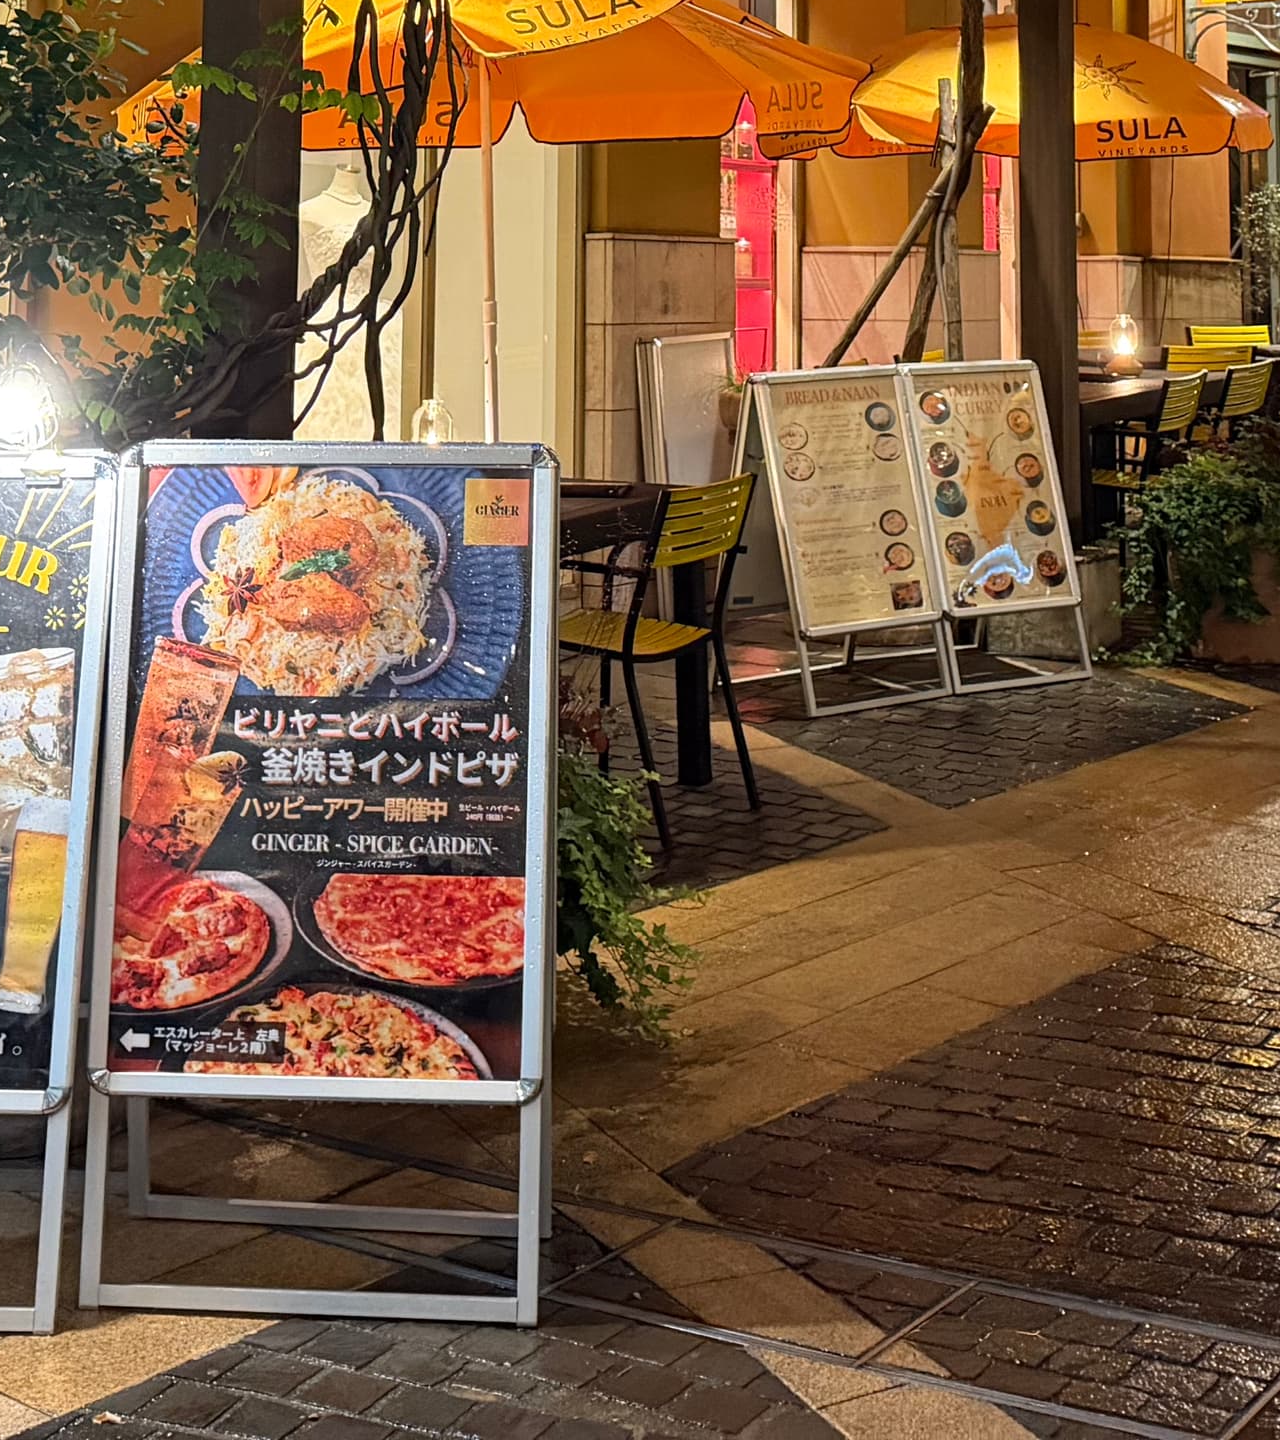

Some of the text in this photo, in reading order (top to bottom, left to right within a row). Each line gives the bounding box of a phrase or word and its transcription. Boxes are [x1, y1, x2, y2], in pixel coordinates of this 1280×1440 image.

[1096, 116, 1188, 143] SULA
[1098, 145, 1189, 157] VINEYARDS
[842, 385, 881, 401] NAAN
[955, 400, 1003, 416] CURRY
[233, 707, 520, 743] ビリヤニとハイボール
[260, 747, 520, 787] 釜焼きインドピザ
[239, 796, 448, 823] ハッピーアワー開催中
[251, 832, 330, 852] GINGER
[346, 835, 404, 853] SPICE
[153, 1026, 245, 1041] エスカレーター上
